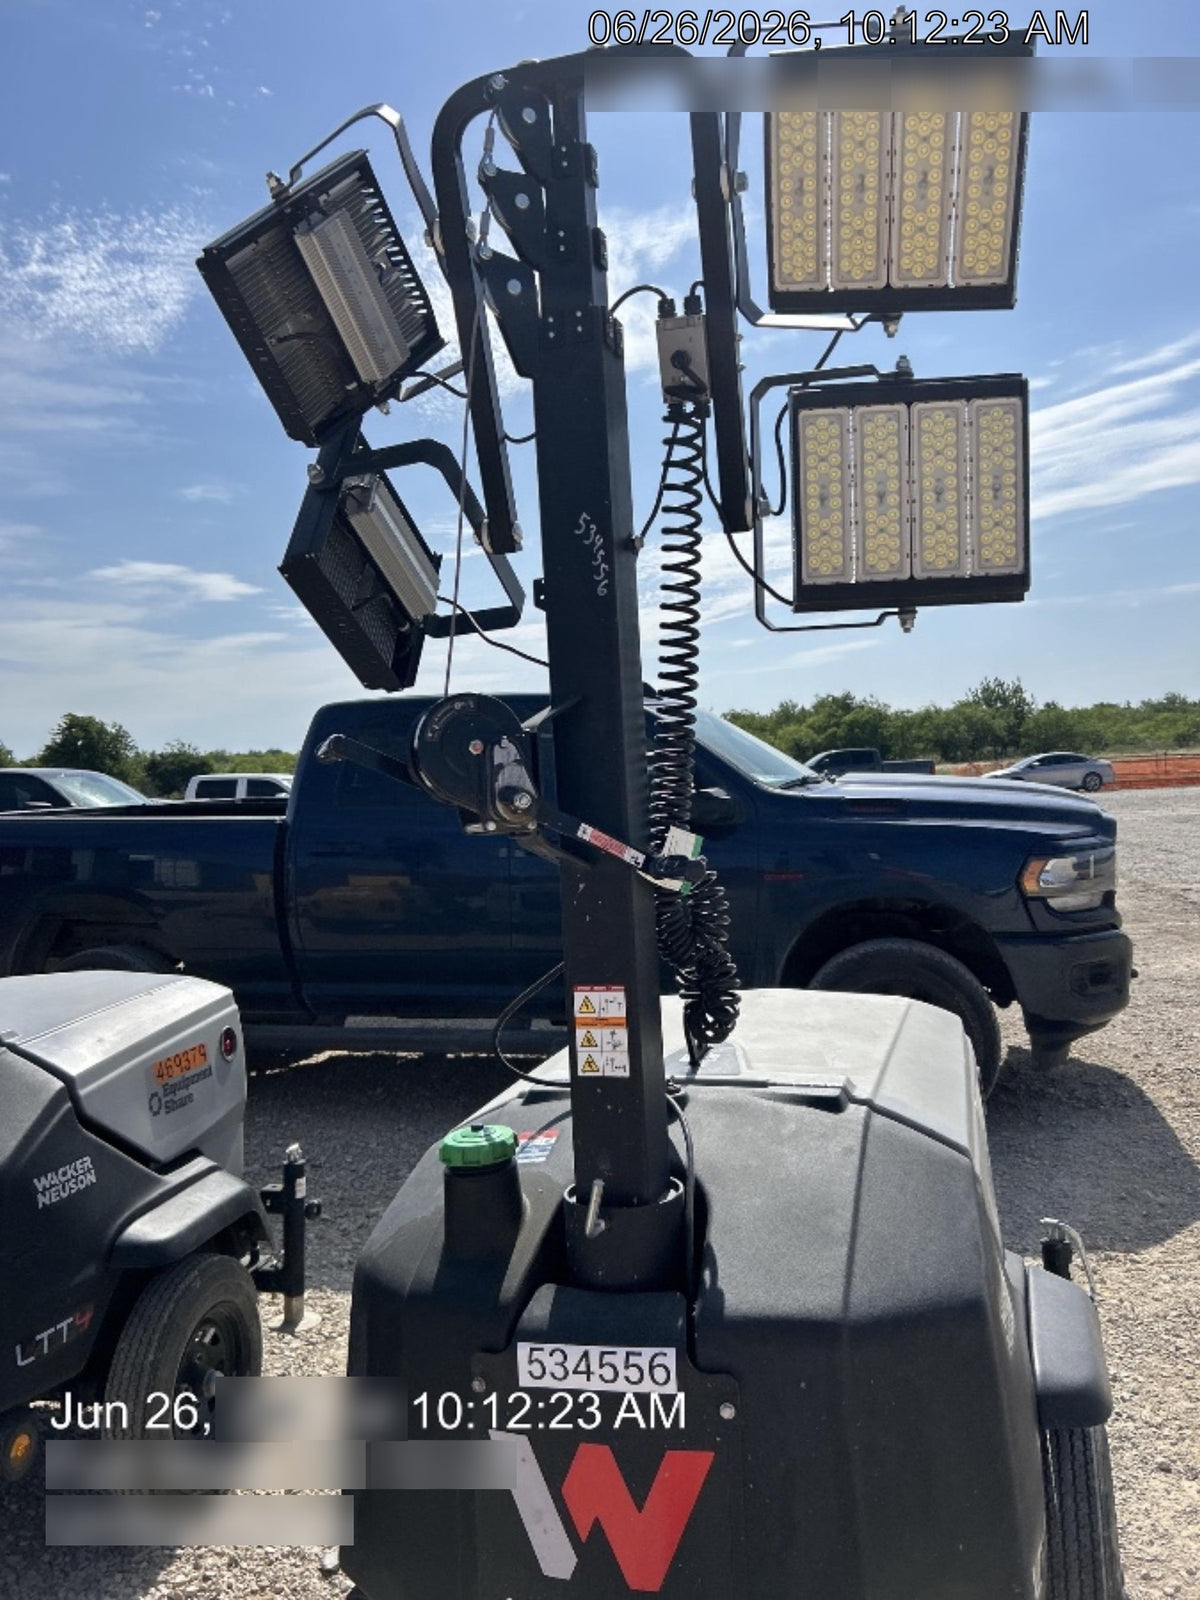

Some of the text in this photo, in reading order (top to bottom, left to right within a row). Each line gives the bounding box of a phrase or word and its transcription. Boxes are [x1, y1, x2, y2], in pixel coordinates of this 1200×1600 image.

[574, 512, 610, 596] 534556
[162, 1065, 213, 1097] Equipment
[164, 1093, 194, 1115] Share
[33, 1155, 93, 1191] WACKER
[37, 1169, 97, 1209] NEUSON
[527, 1346, 671, 1386] 534556
